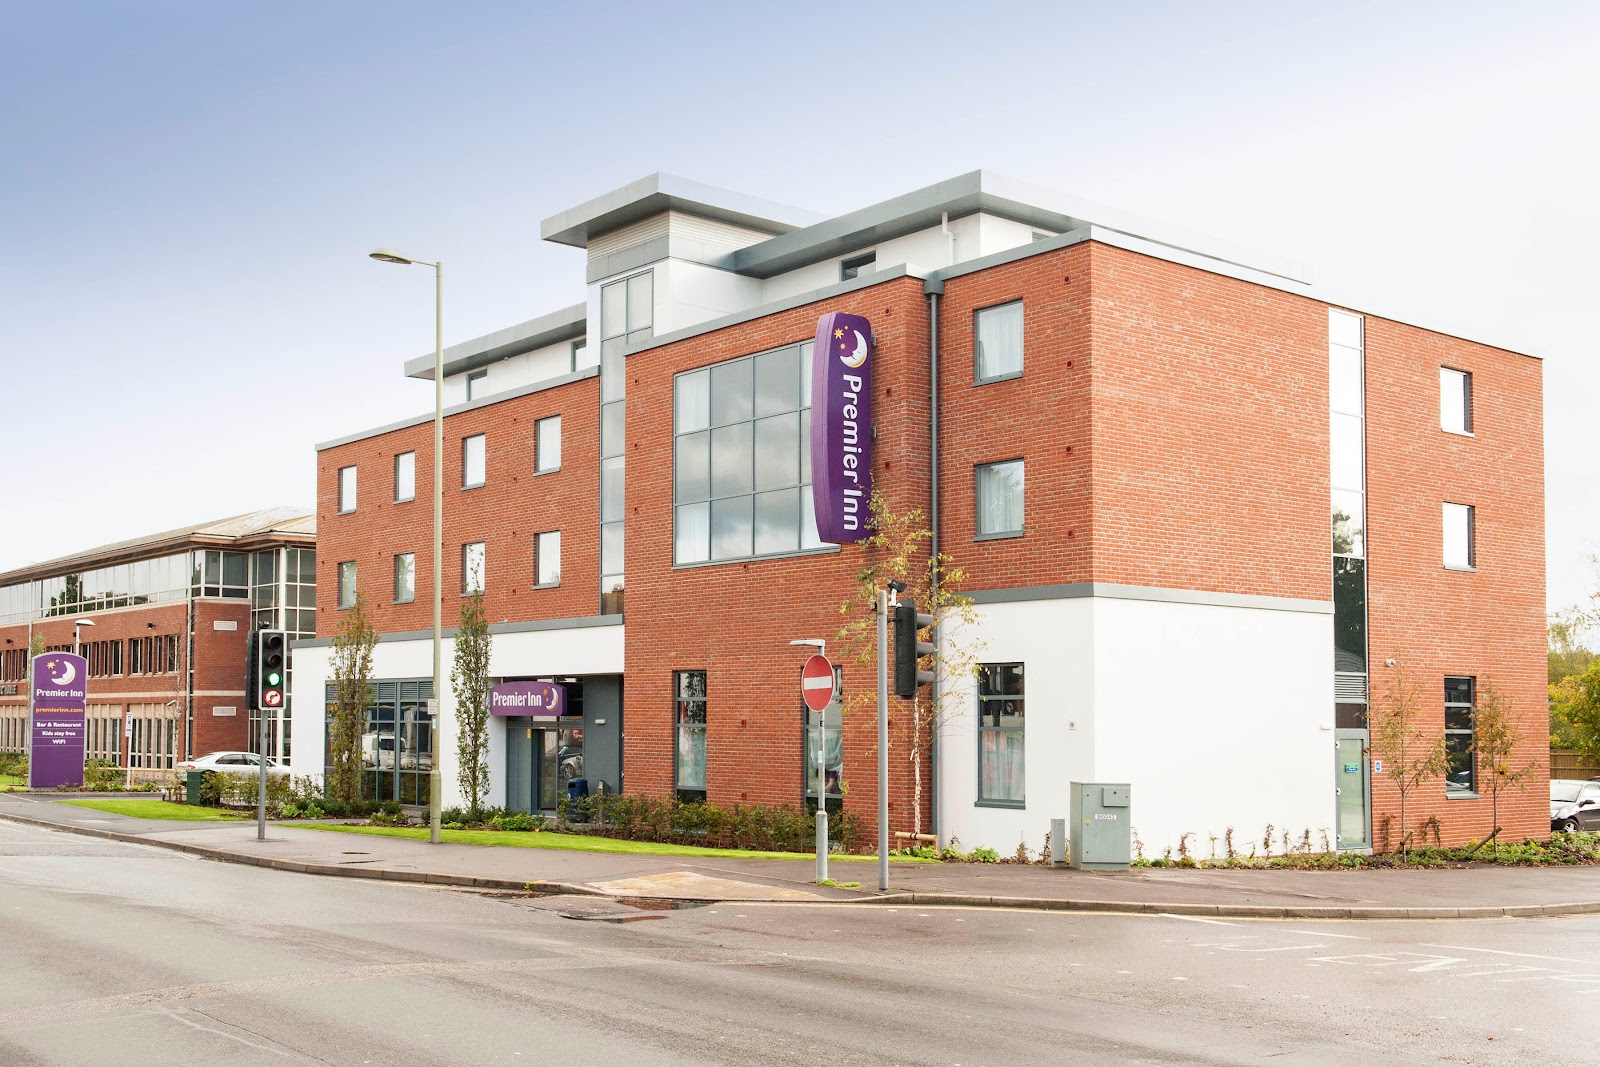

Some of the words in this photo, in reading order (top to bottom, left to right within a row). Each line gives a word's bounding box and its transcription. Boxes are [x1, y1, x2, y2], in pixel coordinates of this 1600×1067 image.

[842, 374, 863, 484] Premier
[842, 488, 862, 531] Inn
[36, 688, 70, 697] Premier
[70, 689, 83, 697] Inn
[492, 691, 527, 706] Premier
[527, 691, 542, 706] Inn
